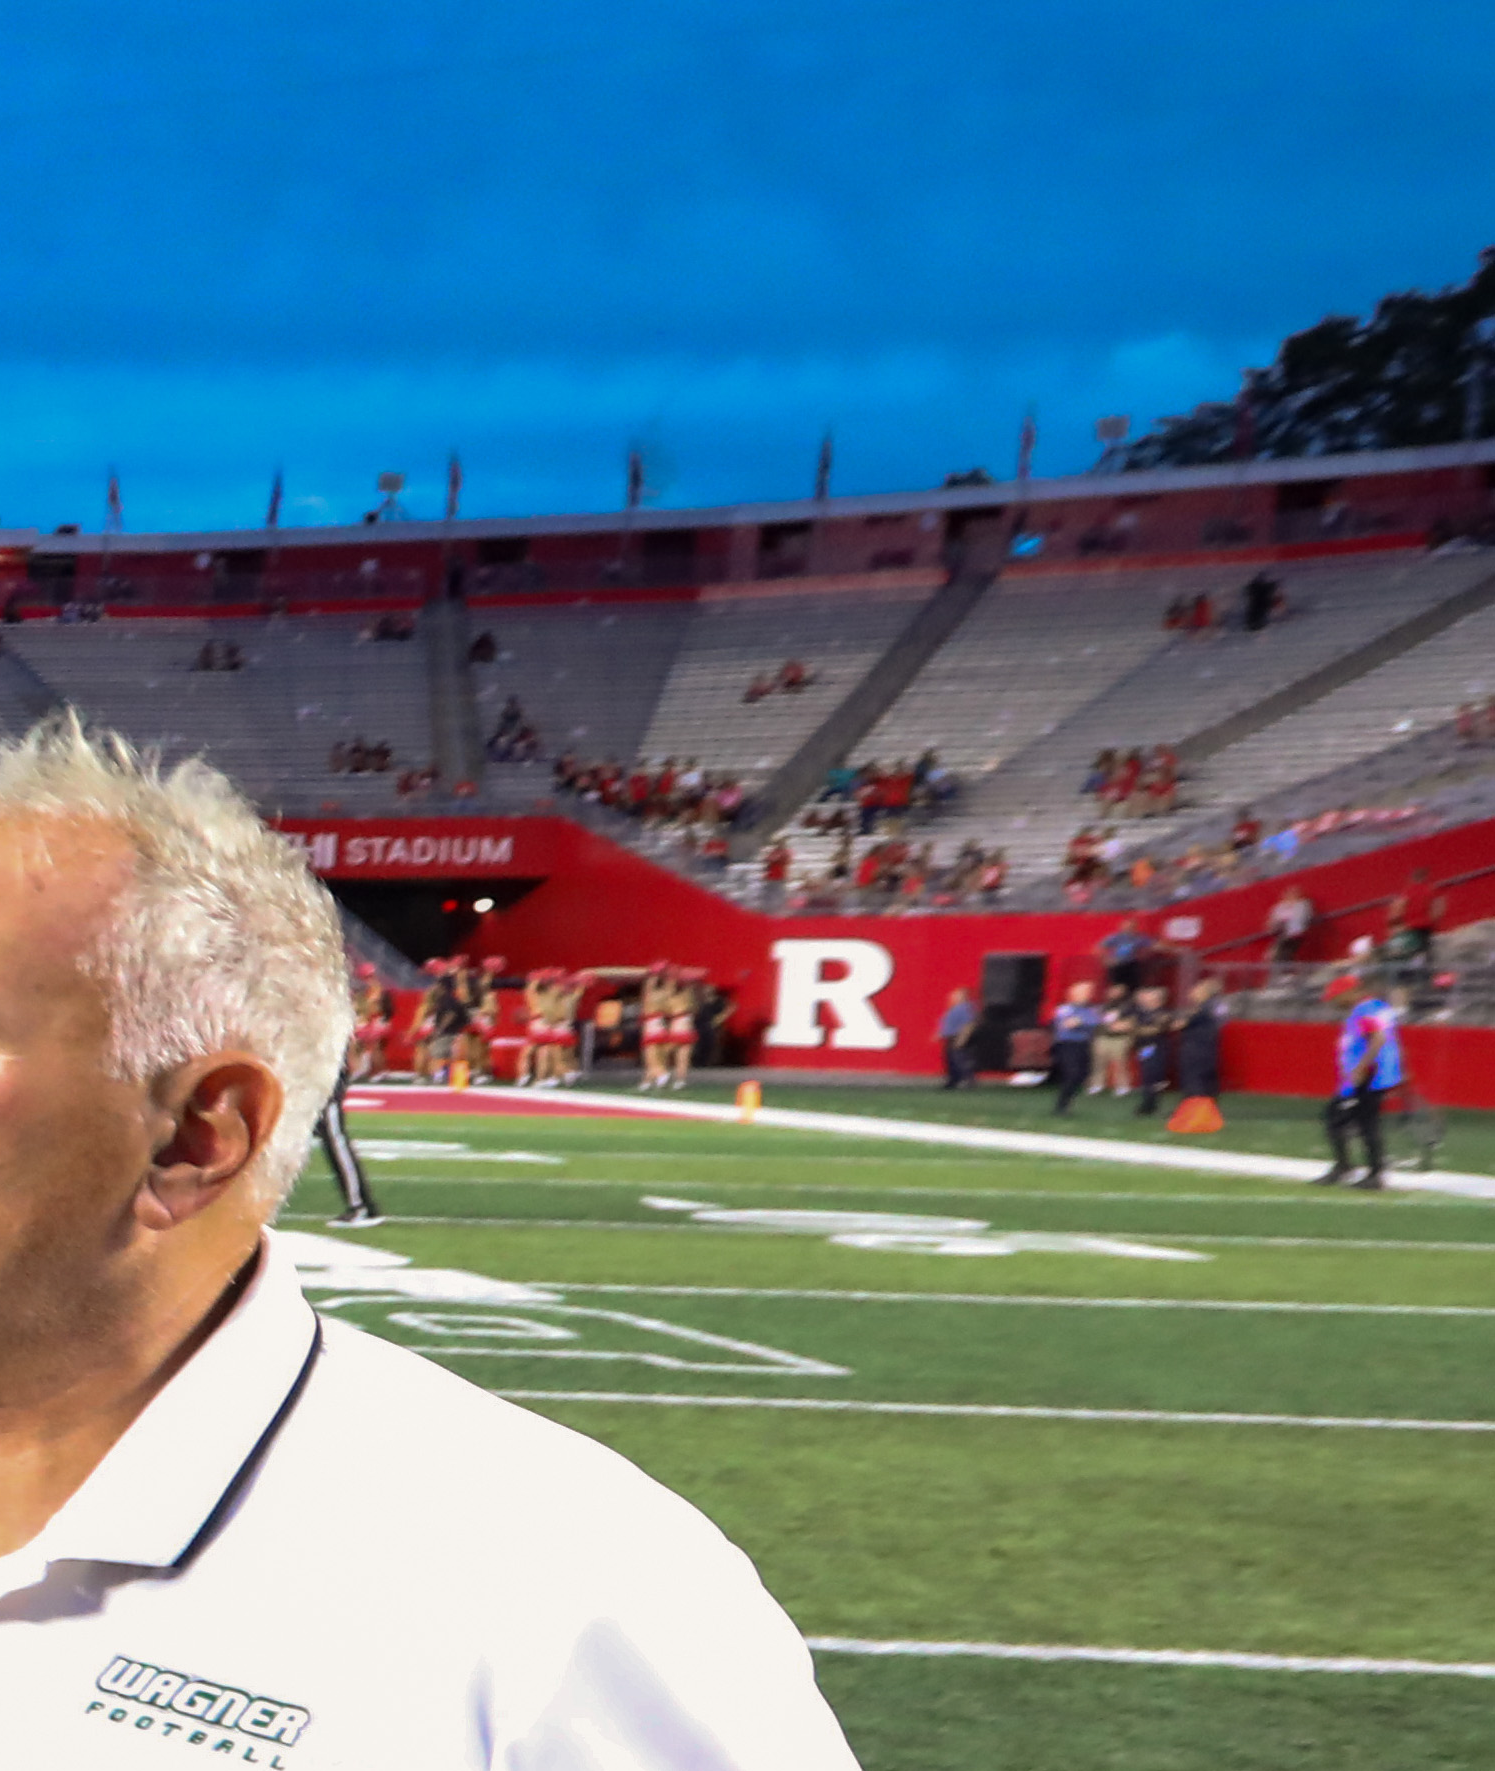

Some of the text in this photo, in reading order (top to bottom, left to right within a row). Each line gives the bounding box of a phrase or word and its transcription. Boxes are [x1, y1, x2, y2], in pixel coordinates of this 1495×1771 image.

[343, 835, 514, 867] STADIUM
[763, 937, 898, 1050] R
[85, 1701, 286, 1771] FOOTBALL
[96, 1654, 311, 1748] WAGNER
